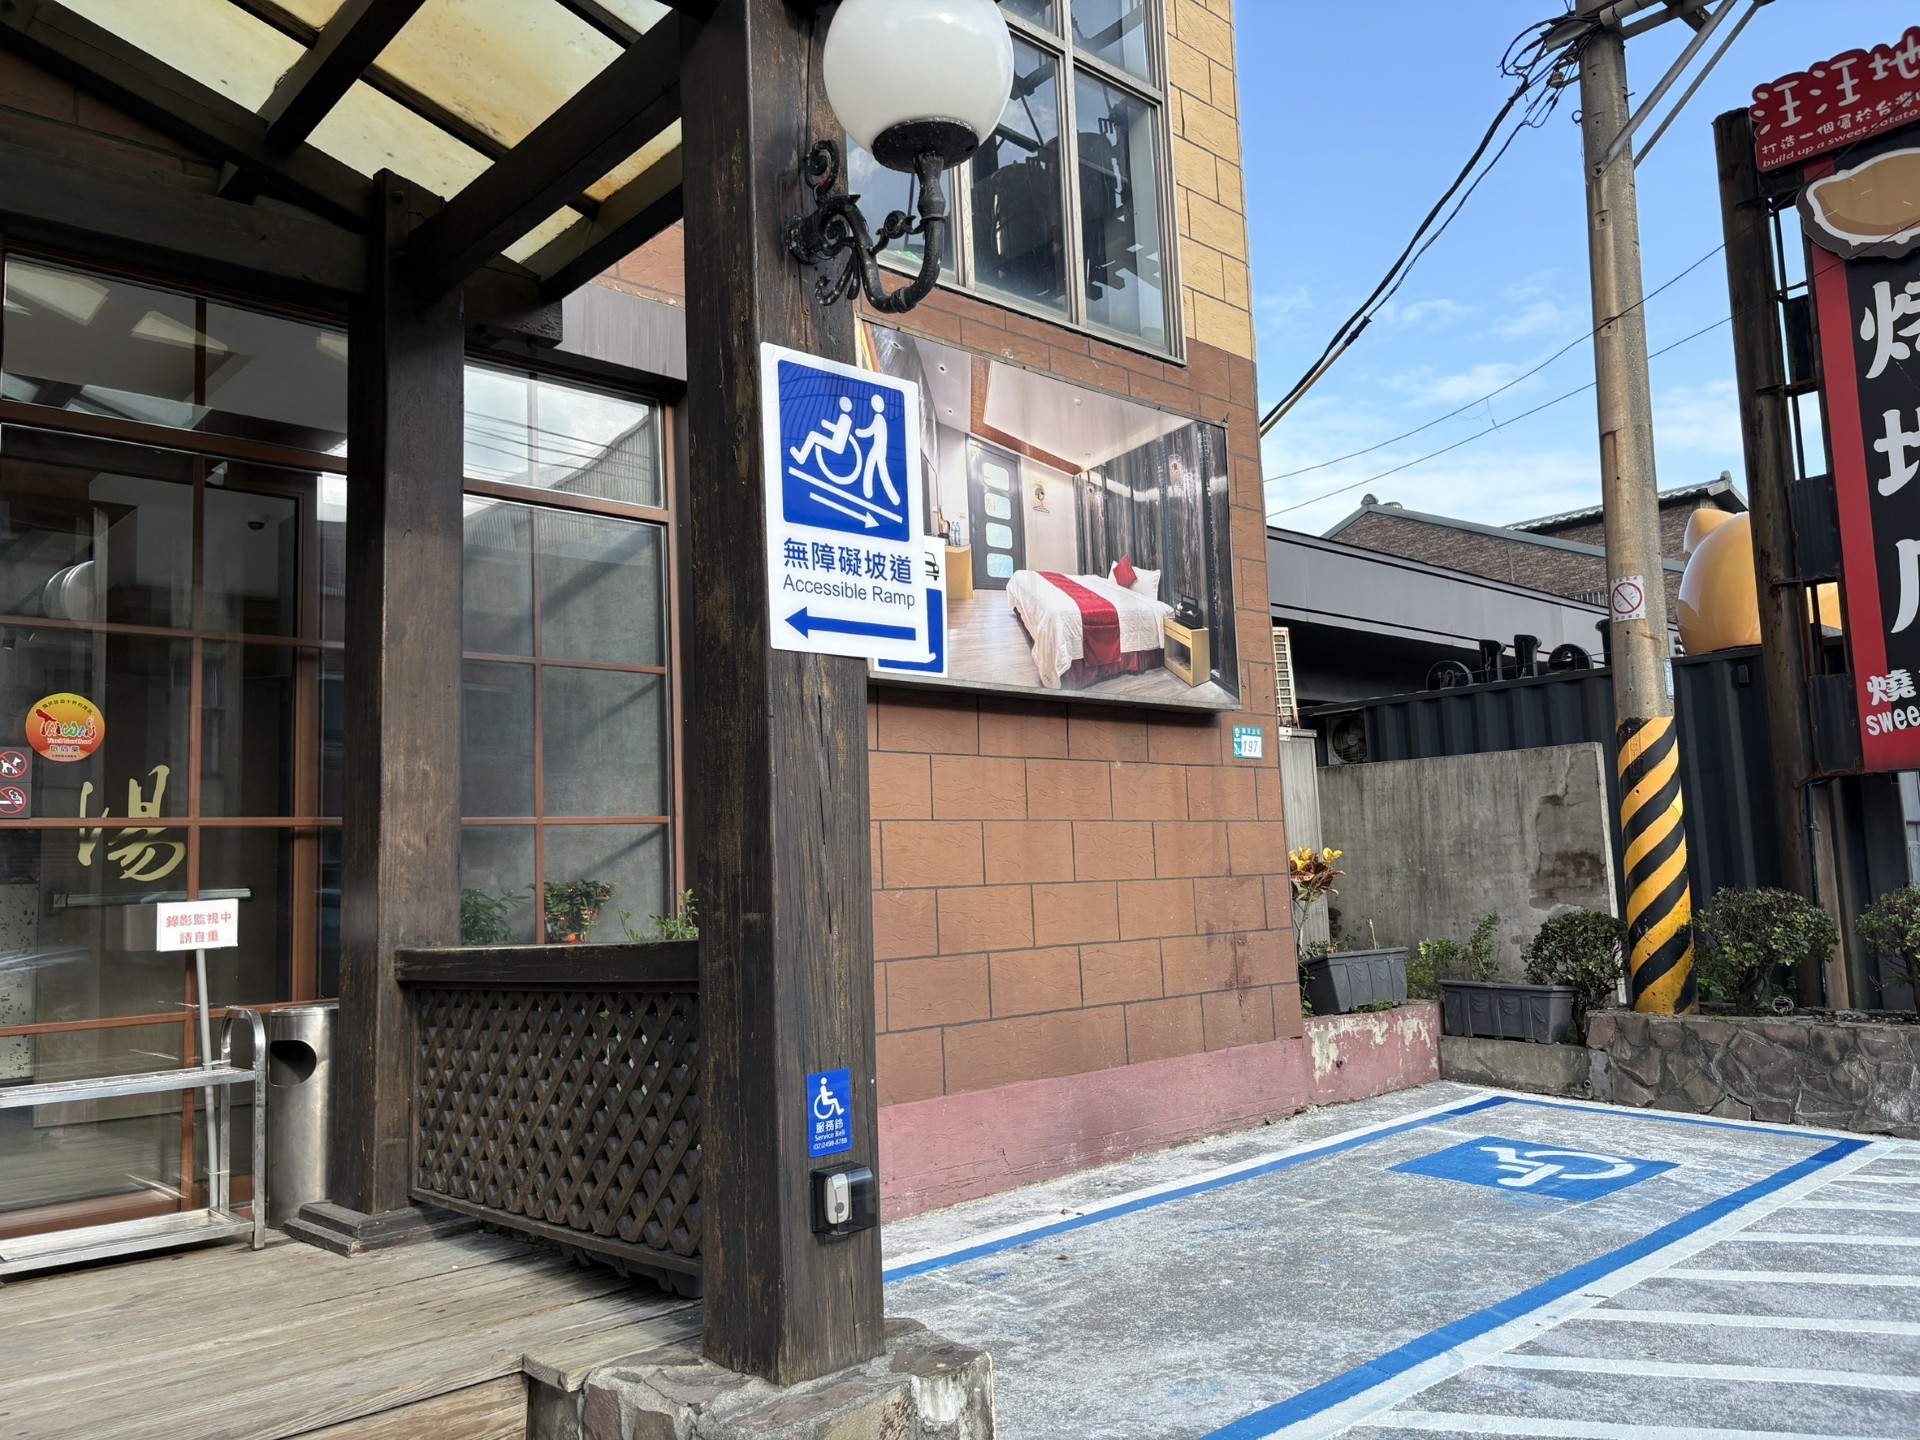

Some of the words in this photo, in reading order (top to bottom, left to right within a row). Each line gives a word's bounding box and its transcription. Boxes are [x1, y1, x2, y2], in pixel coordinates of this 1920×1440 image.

[1761, 91, 1920, 155] 打造一個屬於台灣
[1762, 149, 1794, 168] build
[1798, 146, 1814, 158] up
[1816, 141, 1825, 150] a
[1827, 126, 1869, 146] sweet
[1871, 108, 1919, 133] potato
[783, 537, 913, 585] 無障礙坡道
[783, 574, 867, 601] Accessible
[872, 585, 916, 610] Ramp
[1866, 668, 1920, 706] 燒
[35, 708, 97, 740] Taiwan
[1865, 705, 1920, 736] swee
[1242, 740, 1259, 752] 197
[166, 911, 232, 928] 錄影監視中
[180, 930, 219, 944] 請自重
[814, 1133, 834, 1142] Service
[834, 1129, 846, 1137] Bell
[816, 1118, 844, 1133] 服務鈴
